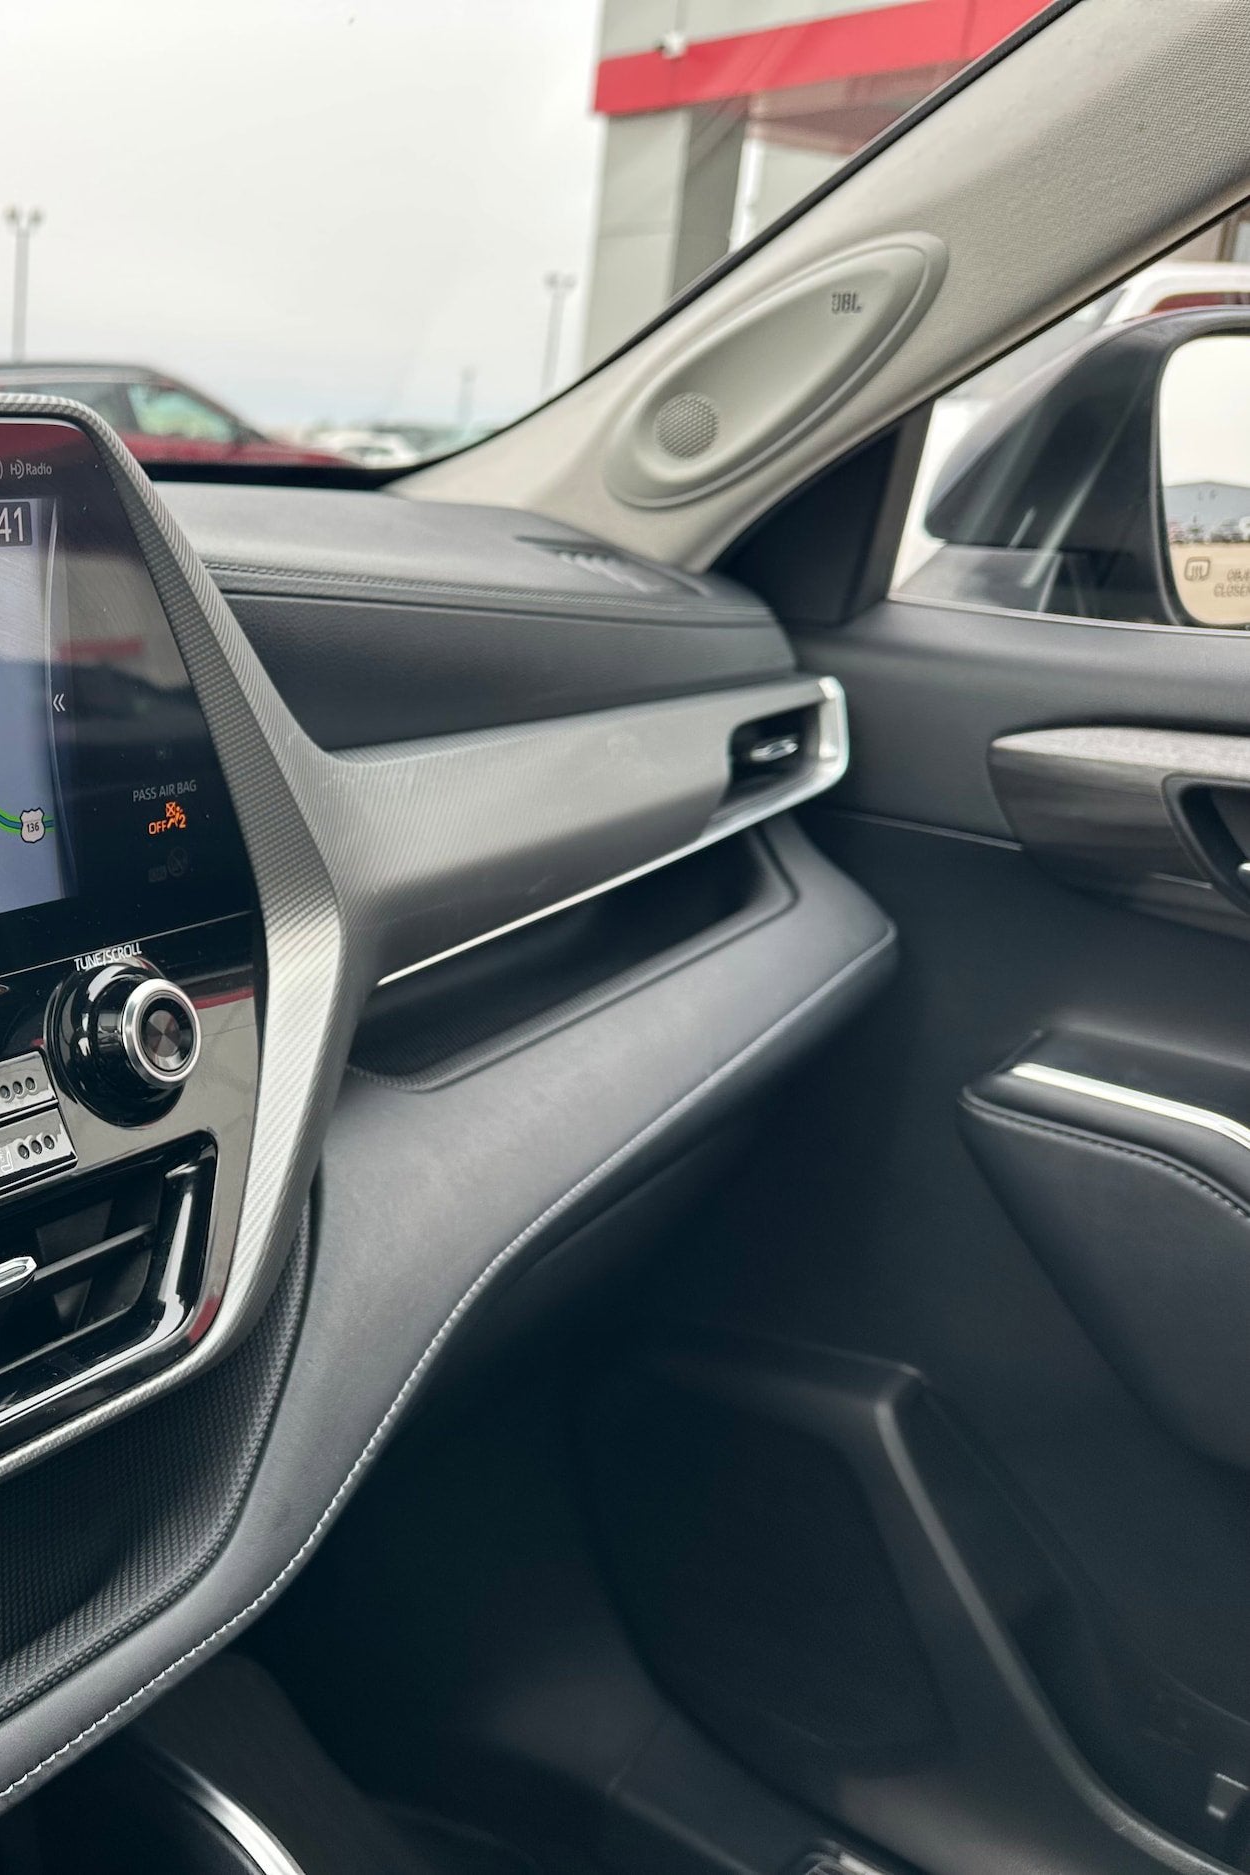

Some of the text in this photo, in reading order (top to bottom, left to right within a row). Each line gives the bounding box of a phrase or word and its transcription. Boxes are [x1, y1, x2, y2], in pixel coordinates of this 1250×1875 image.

[831, 292, 862, 314] JBL
[26, 463, 52, 475] Radio
[133, 780, 196, 802] PASS AIR BAG
[27, 822, 39, 832] 136
[148, 820, 166, 834] OFF
[74, 942, 142, 972] TUNE/SCROLL
